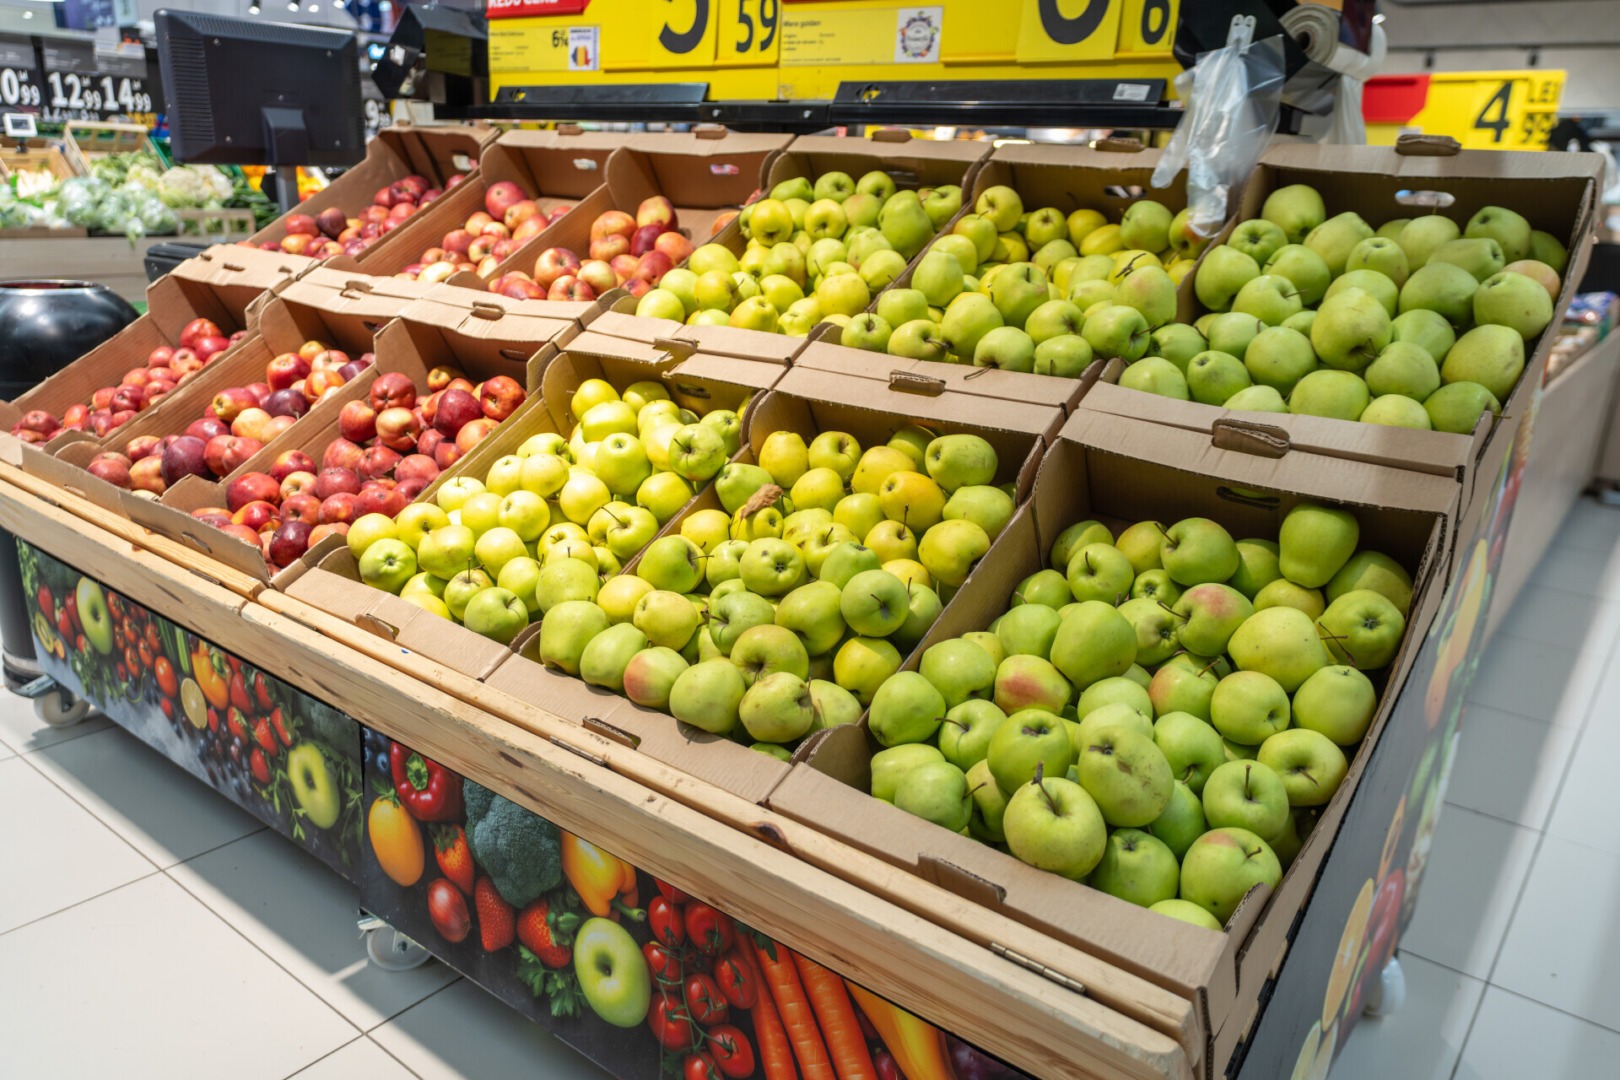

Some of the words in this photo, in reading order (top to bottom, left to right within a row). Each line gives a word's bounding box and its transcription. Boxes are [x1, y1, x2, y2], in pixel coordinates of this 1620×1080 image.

[0, 68, 20, 105] 0
[20, 84, 41, 107] 99
[48, 71, 86, 109] 12
[83, 89, 102, 111] 99
[101, 75, 136, 113] 14
[134, 92, 152, 113] 99
[1474, 80, 1512, 143] 4
